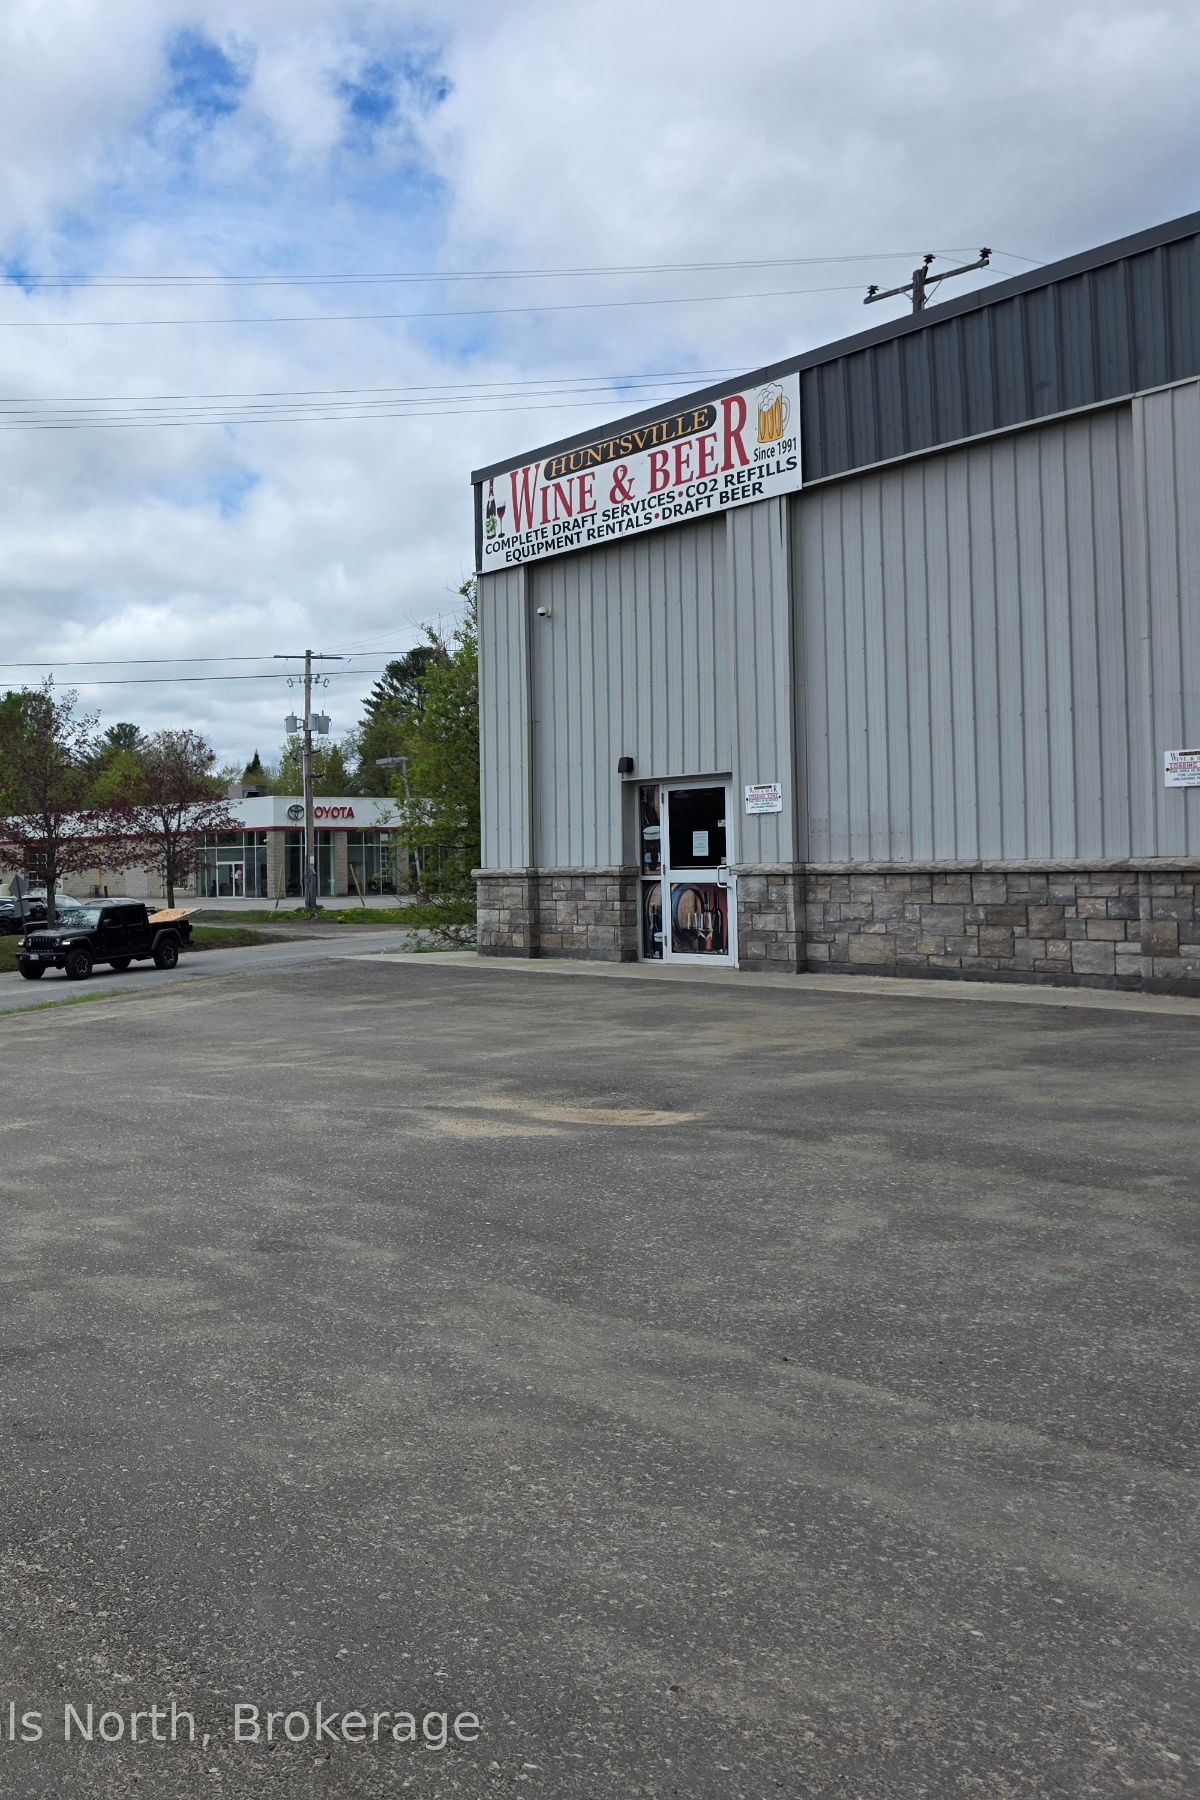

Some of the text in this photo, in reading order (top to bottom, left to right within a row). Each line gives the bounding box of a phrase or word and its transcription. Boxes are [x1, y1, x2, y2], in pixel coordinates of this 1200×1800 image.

[510, 395, 750, 532] WINE & BEER
[550, 408, 710, 478] HUNTSVILLE
[753, 438, 797, 462] Since 1991
[485, 456, 797, 555] COMPLETE DRAFT SERVICES CO2 REFILLS
[506, 481, 764, 562] EQUIPMENT RENTALS DRAFT BEER
[312, 806, 354, 818] OYOTA
